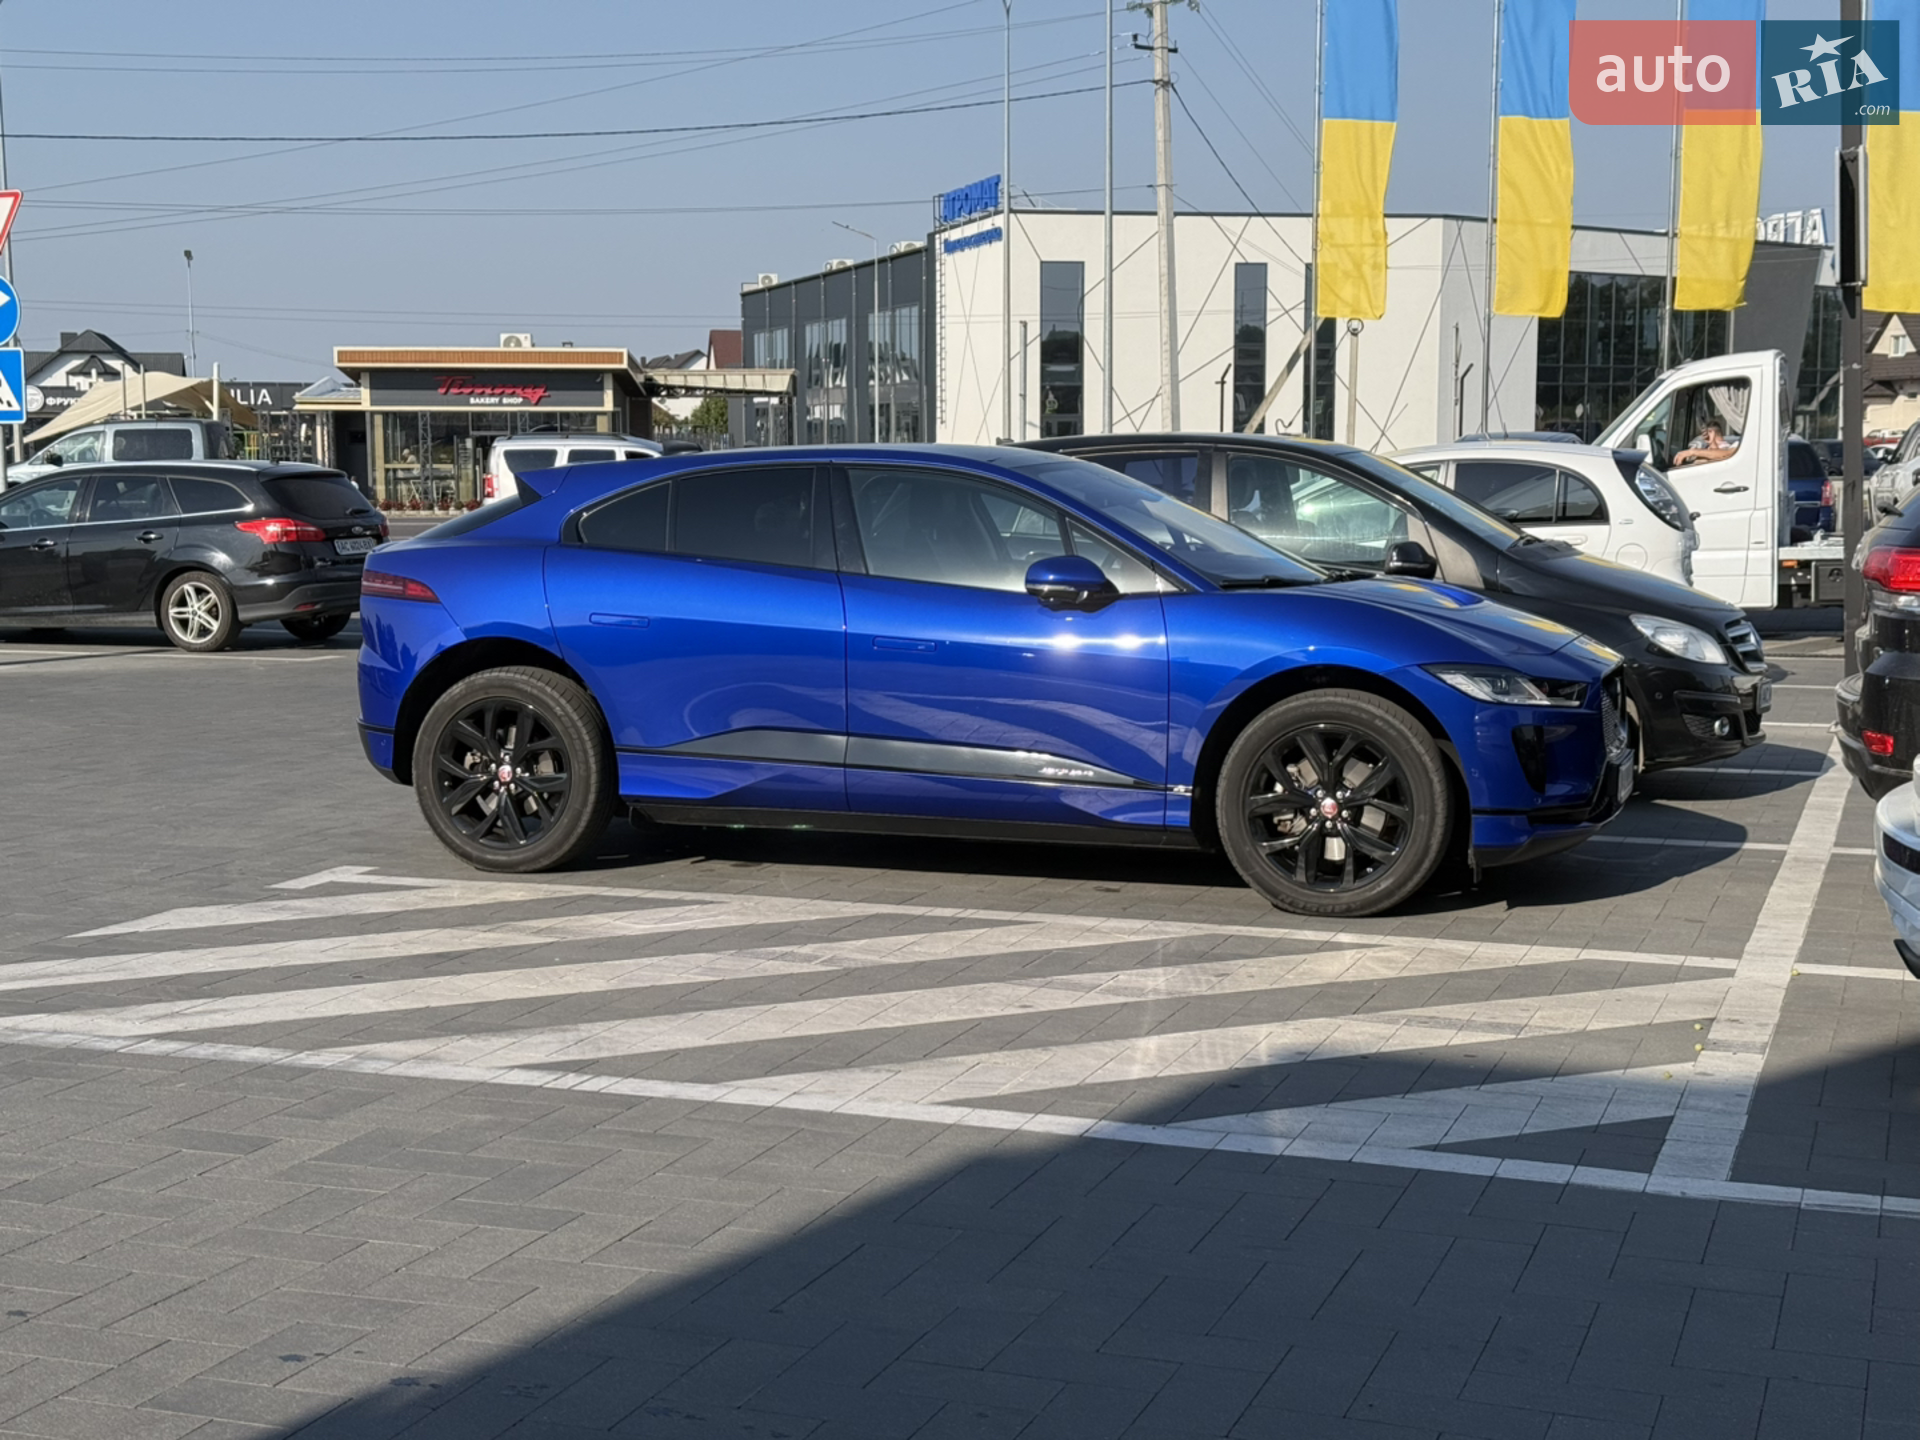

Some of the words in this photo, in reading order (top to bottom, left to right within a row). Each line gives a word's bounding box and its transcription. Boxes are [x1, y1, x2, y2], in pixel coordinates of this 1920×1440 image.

[943, 173, 1002, 222] АГРОМАТ
[469, 397, 500, 405] BAKERY
[502, 397, 524, 405] SHOP
